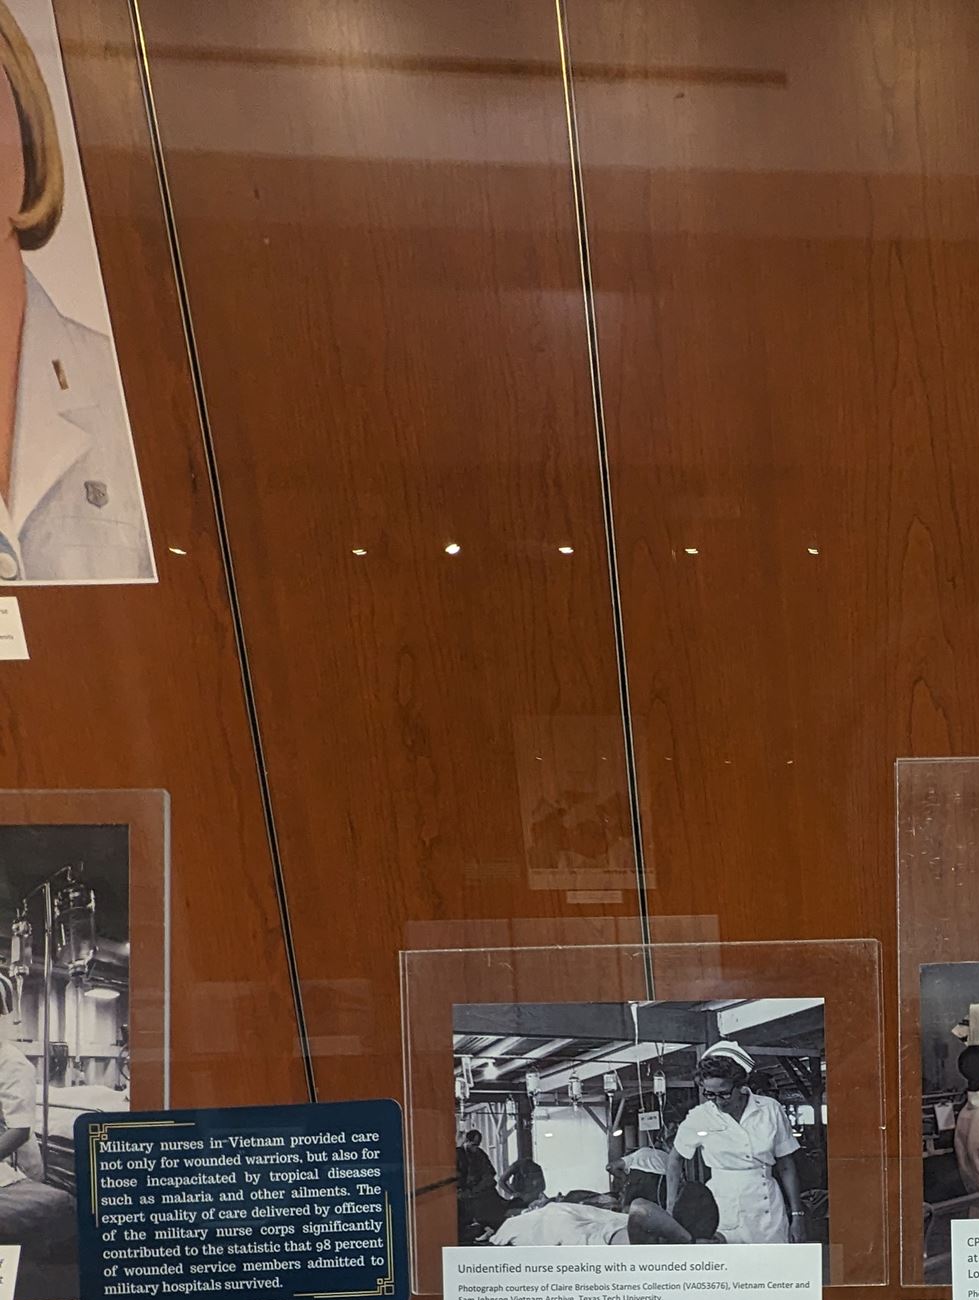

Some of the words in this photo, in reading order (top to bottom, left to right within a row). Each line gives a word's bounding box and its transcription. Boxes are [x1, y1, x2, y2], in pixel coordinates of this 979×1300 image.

[99, 1140, 153, 1153] Military
[160, 1140, 203, 1150] nurses
[209, 1138, 222, 1148] in
[229, 1136, 284, 1148] Vietnam
[290, 1132, 346, 1148] provided
[351, 1133, 379, 1142] care
[100, 1159, 123, 1170] not
[127, 1157, 156, 1171] only
[161, 1156, 179, 1168] for
[183, 1154, 241, 1167] wounded
[245, 1152, 302, 1164] warriors,
[306, 1151, 328, 1162] but
[332, 1149, 358, 1161] also
[362, 1147, 380, 1159] for
[101, 1177, 137, 1188] those
[147, 1172, 236, 1188] incapacitated
[244, 1171, 260, 1185] by
[269, 1168, 319, 1183] tropical
[327, 1167, 380, 1178] diseases
[101, 1194, 132, 1205] such
[139, 1195, 155, 1204] as
[161, 1190, 213, 1203] malaria
[219, 1189, 244, 1201] and
[250, 1188, 285, 1200] other
[291, 1186, 350, 1198] ailments.
[356, 1184, 381, 1195] The
[101, 1212, 145, 1225] expert
[150, 1209, 197, 1224] quality
[201, 1208, 215, 1219] of
[218, 1209, 247, 1219] care
[251, 1204, 310, 1217] delivered
[314, 1204, 330, 1217] by
[334, 1202, 382, 1214] officers
[102, 1229, 117, 1241] of
[124, 1229, 146, 1240] the
[154, 1227, 208, 1240] military
[216, 1227, 252, 1237] nurse
[260, 1225, 294, 1236] corps
[302, 1219, 382, 1236] significantly
[103, 1245, 181, 1259] contributed
[184, 1245, 198, 1256] to
[202, 1244, 223, 1255] the
[227, 1241, 280, 1254] statistic
[284, 1240, 312, 1252] that
[316, 1239, 331, 1252] 98
[335, 1237, 383, 1252] percent
[967, 1254, 978, 1262] at
[103, 1265, 118, 1276] of
[124, 1263, 183, 1276] wounded
[190, 1261, 236, 1273] service
[243, 1259, 301, 1271] members
[307, 1255, 364, 1268] admitted
[371, 1255, 384, 1266] to
[458, 1263, 521, 1273] Unidentified
[556, 1262, 601, 1274] speaking
[604, 1262, 627, 1271] with
[638, 1261, 686, 1271] wounded
[689, 1261, 727, 1271] soldier.
[104, 1282, 159, 1295] military
[162, 1279, 221, 1293] hospitals
[224, 1276, 282, 1290] survived.
[458, 1284, 503, 1293] Photograph
[540, 1283, 549, 1291] of
[550, 1283, 572, 1291] Claire
[575, 1283, 610, 1291] Brisebois
[642, 1282, 680, 1290] Collection
